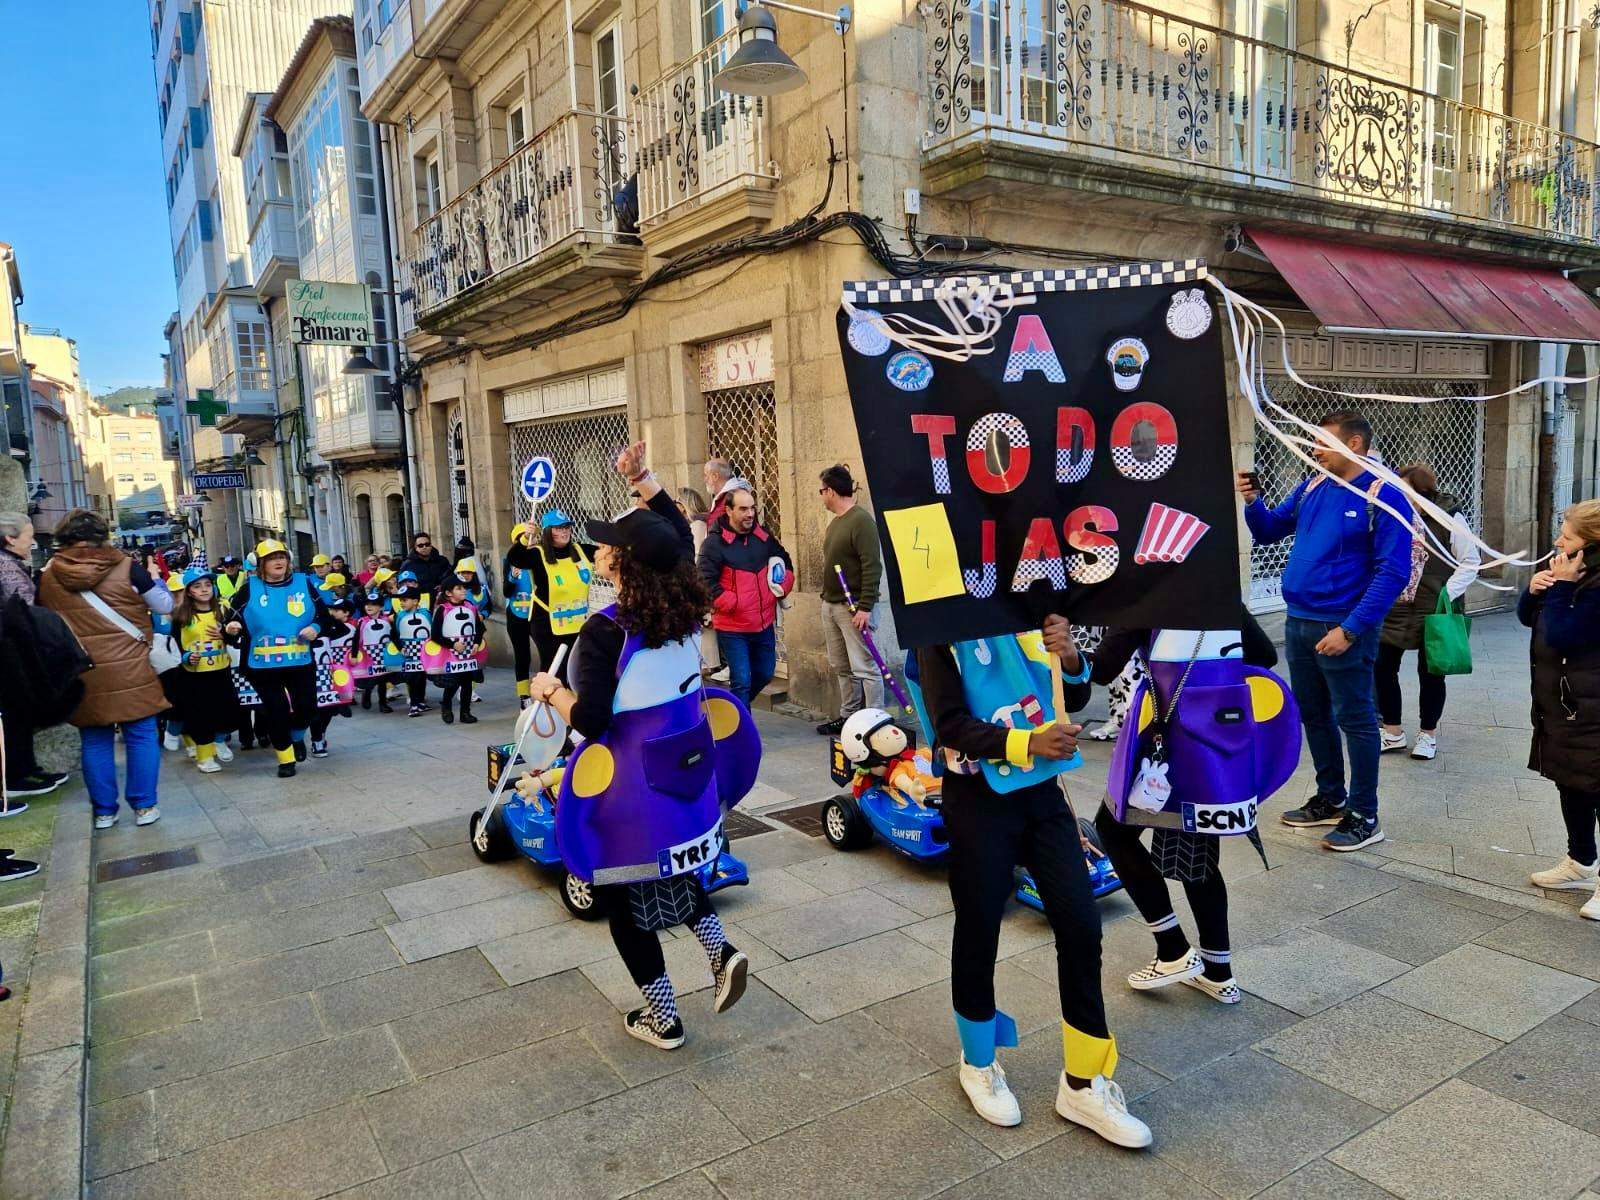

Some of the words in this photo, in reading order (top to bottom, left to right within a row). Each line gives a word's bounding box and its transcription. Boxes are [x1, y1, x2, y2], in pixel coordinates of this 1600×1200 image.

[291, 283, 324, 301] Piel
[297, 301, 369, 324] Confecciones
[293, 316, 369, 341] Tamara
[1002, 314, 1067, 384] A
[911, 402, 1179, 496] TODO
[195, 476, 244, 488] ORTOPEDIA
[912, 526, 931, 570] 4
[1197, 808, 1247, 830] SCN
[892, 828, 905, 840] TEAM
[672, 839, 710, 870] YRF
